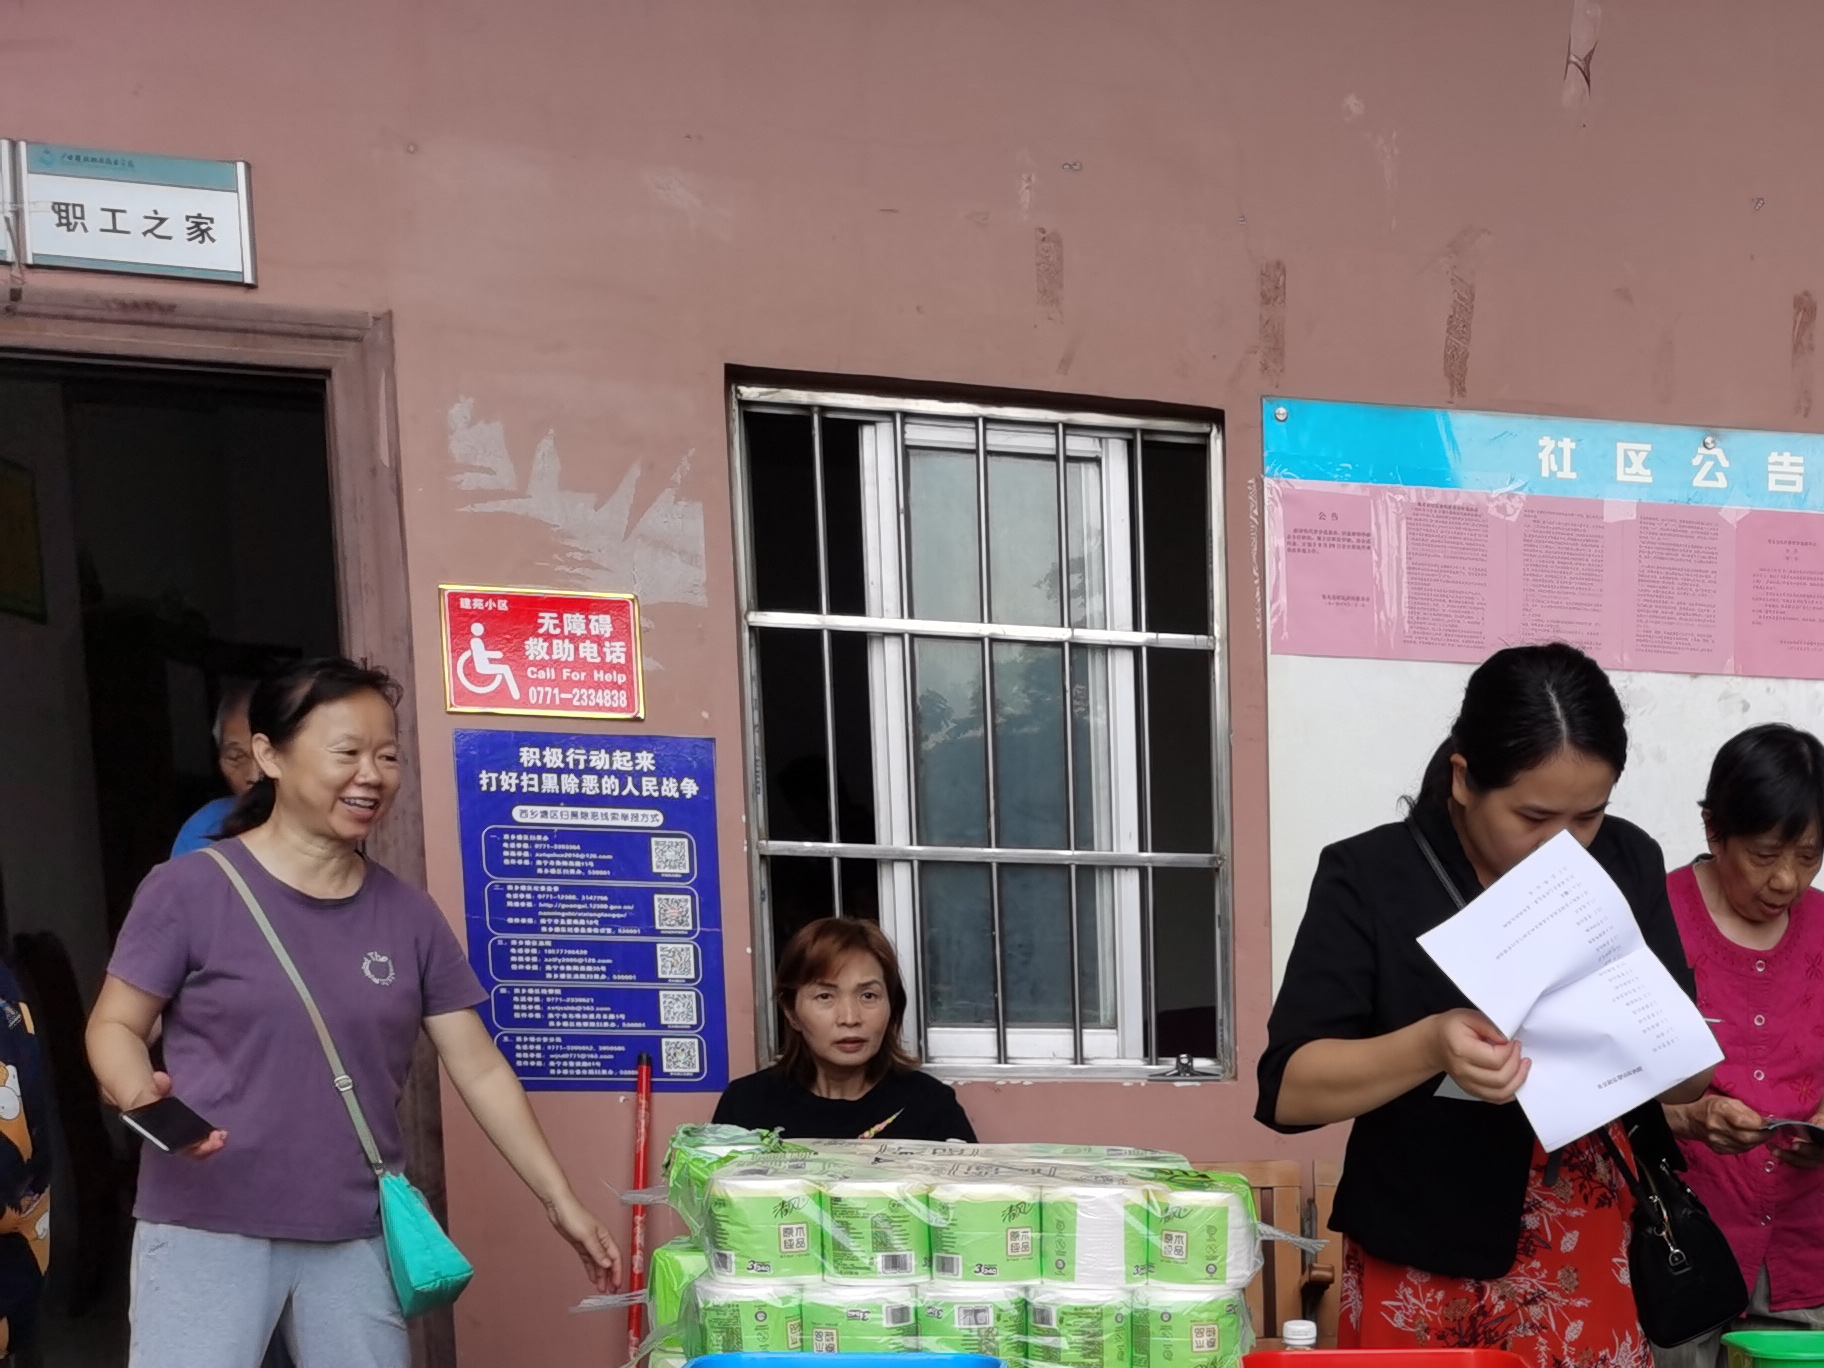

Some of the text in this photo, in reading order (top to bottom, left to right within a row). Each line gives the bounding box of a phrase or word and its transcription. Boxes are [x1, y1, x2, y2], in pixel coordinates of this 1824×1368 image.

[51, 201, 217, 244] 职工之家
[537, 612, 613, 637] 无障碍
[524, 638, 627, 664] 救助电话
[526, 666, 627, 685] Call For Help
[519, 746, 656, 772] 积极行动起来
[479, 769, 699, 799] 打好扫黑除恶的人民战争
